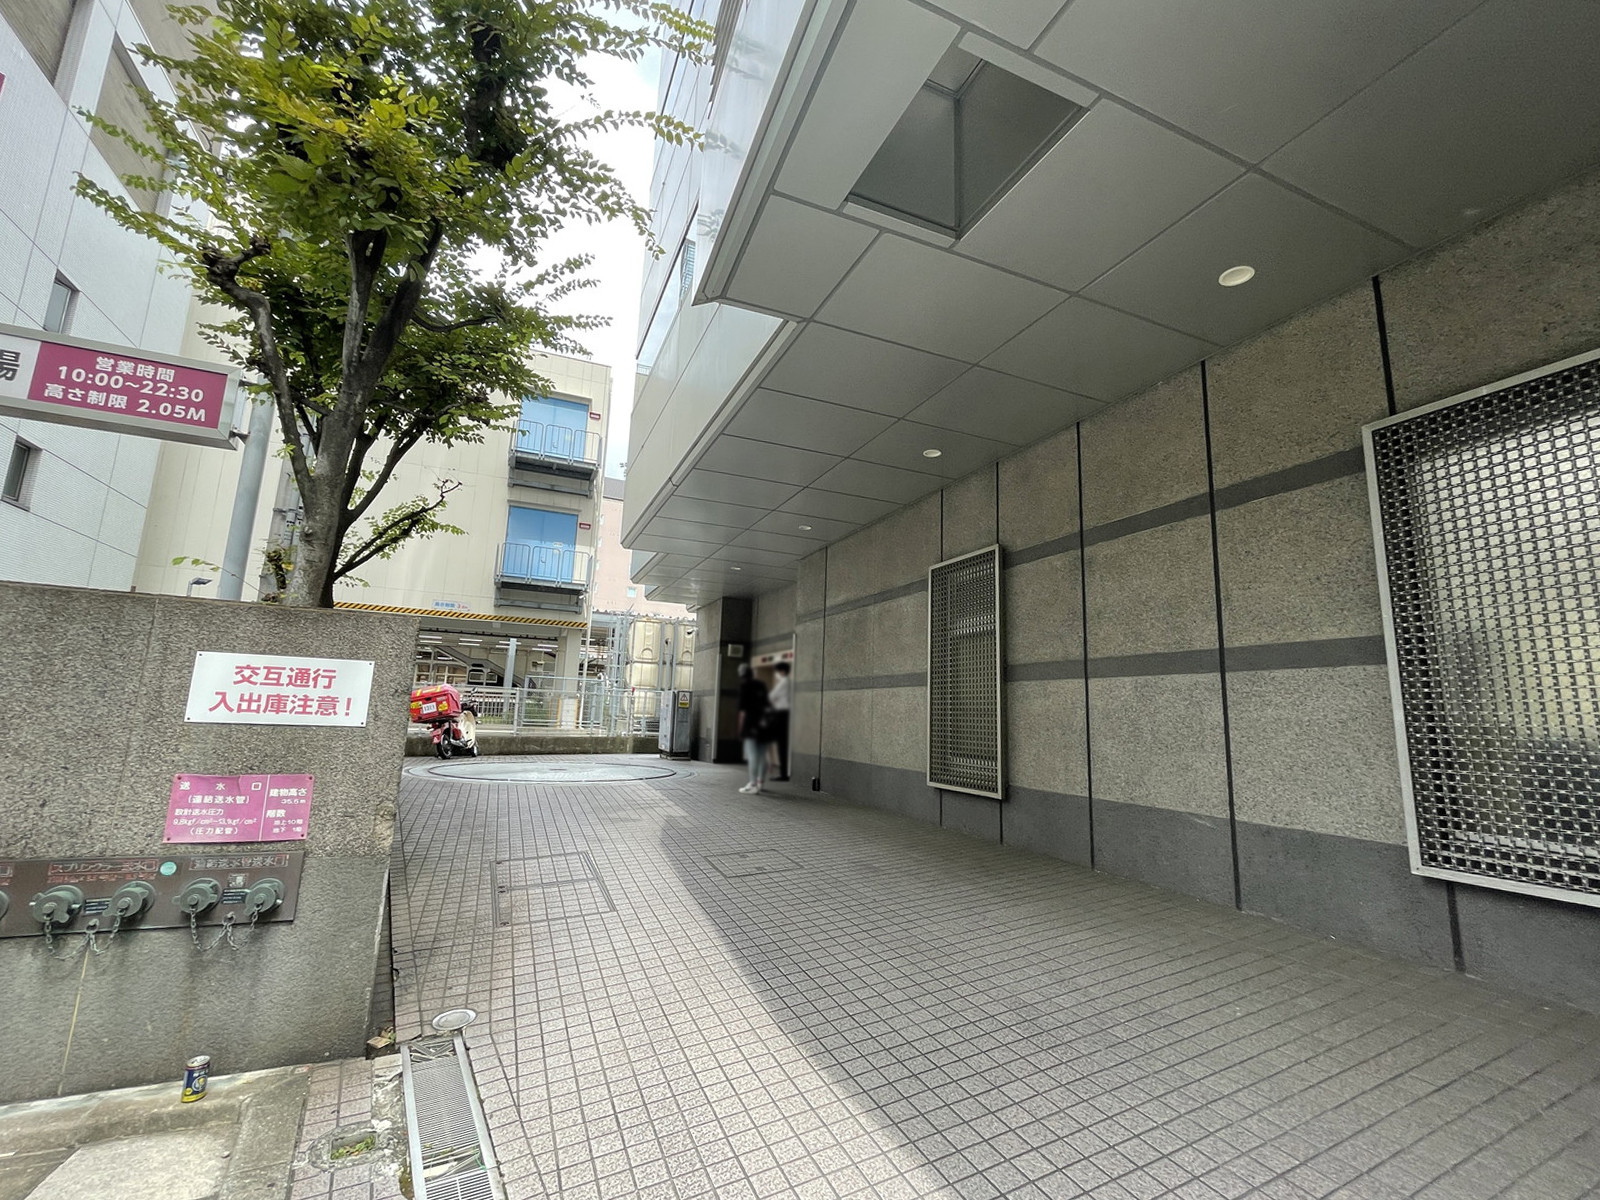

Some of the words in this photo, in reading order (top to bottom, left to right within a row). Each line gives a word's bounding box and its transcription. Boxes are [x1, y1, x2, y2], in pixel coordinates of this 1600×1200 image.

[95, 356, 175, 383] 営業時間
[57, 365, 204, 403] 10:00~22:30
[43, 383, 128, 409] 高さ制限
[136, 399, 207, 422] 2.05M
[233, 664, 337, 690] 交互通行
[208, 691, 353, 717] 入出庫注意!
[188, 795, 250, 804] (連結送水管)
[269, 788, 308, 797] 建物高さ
[266, 809, 287, 818] 階数
